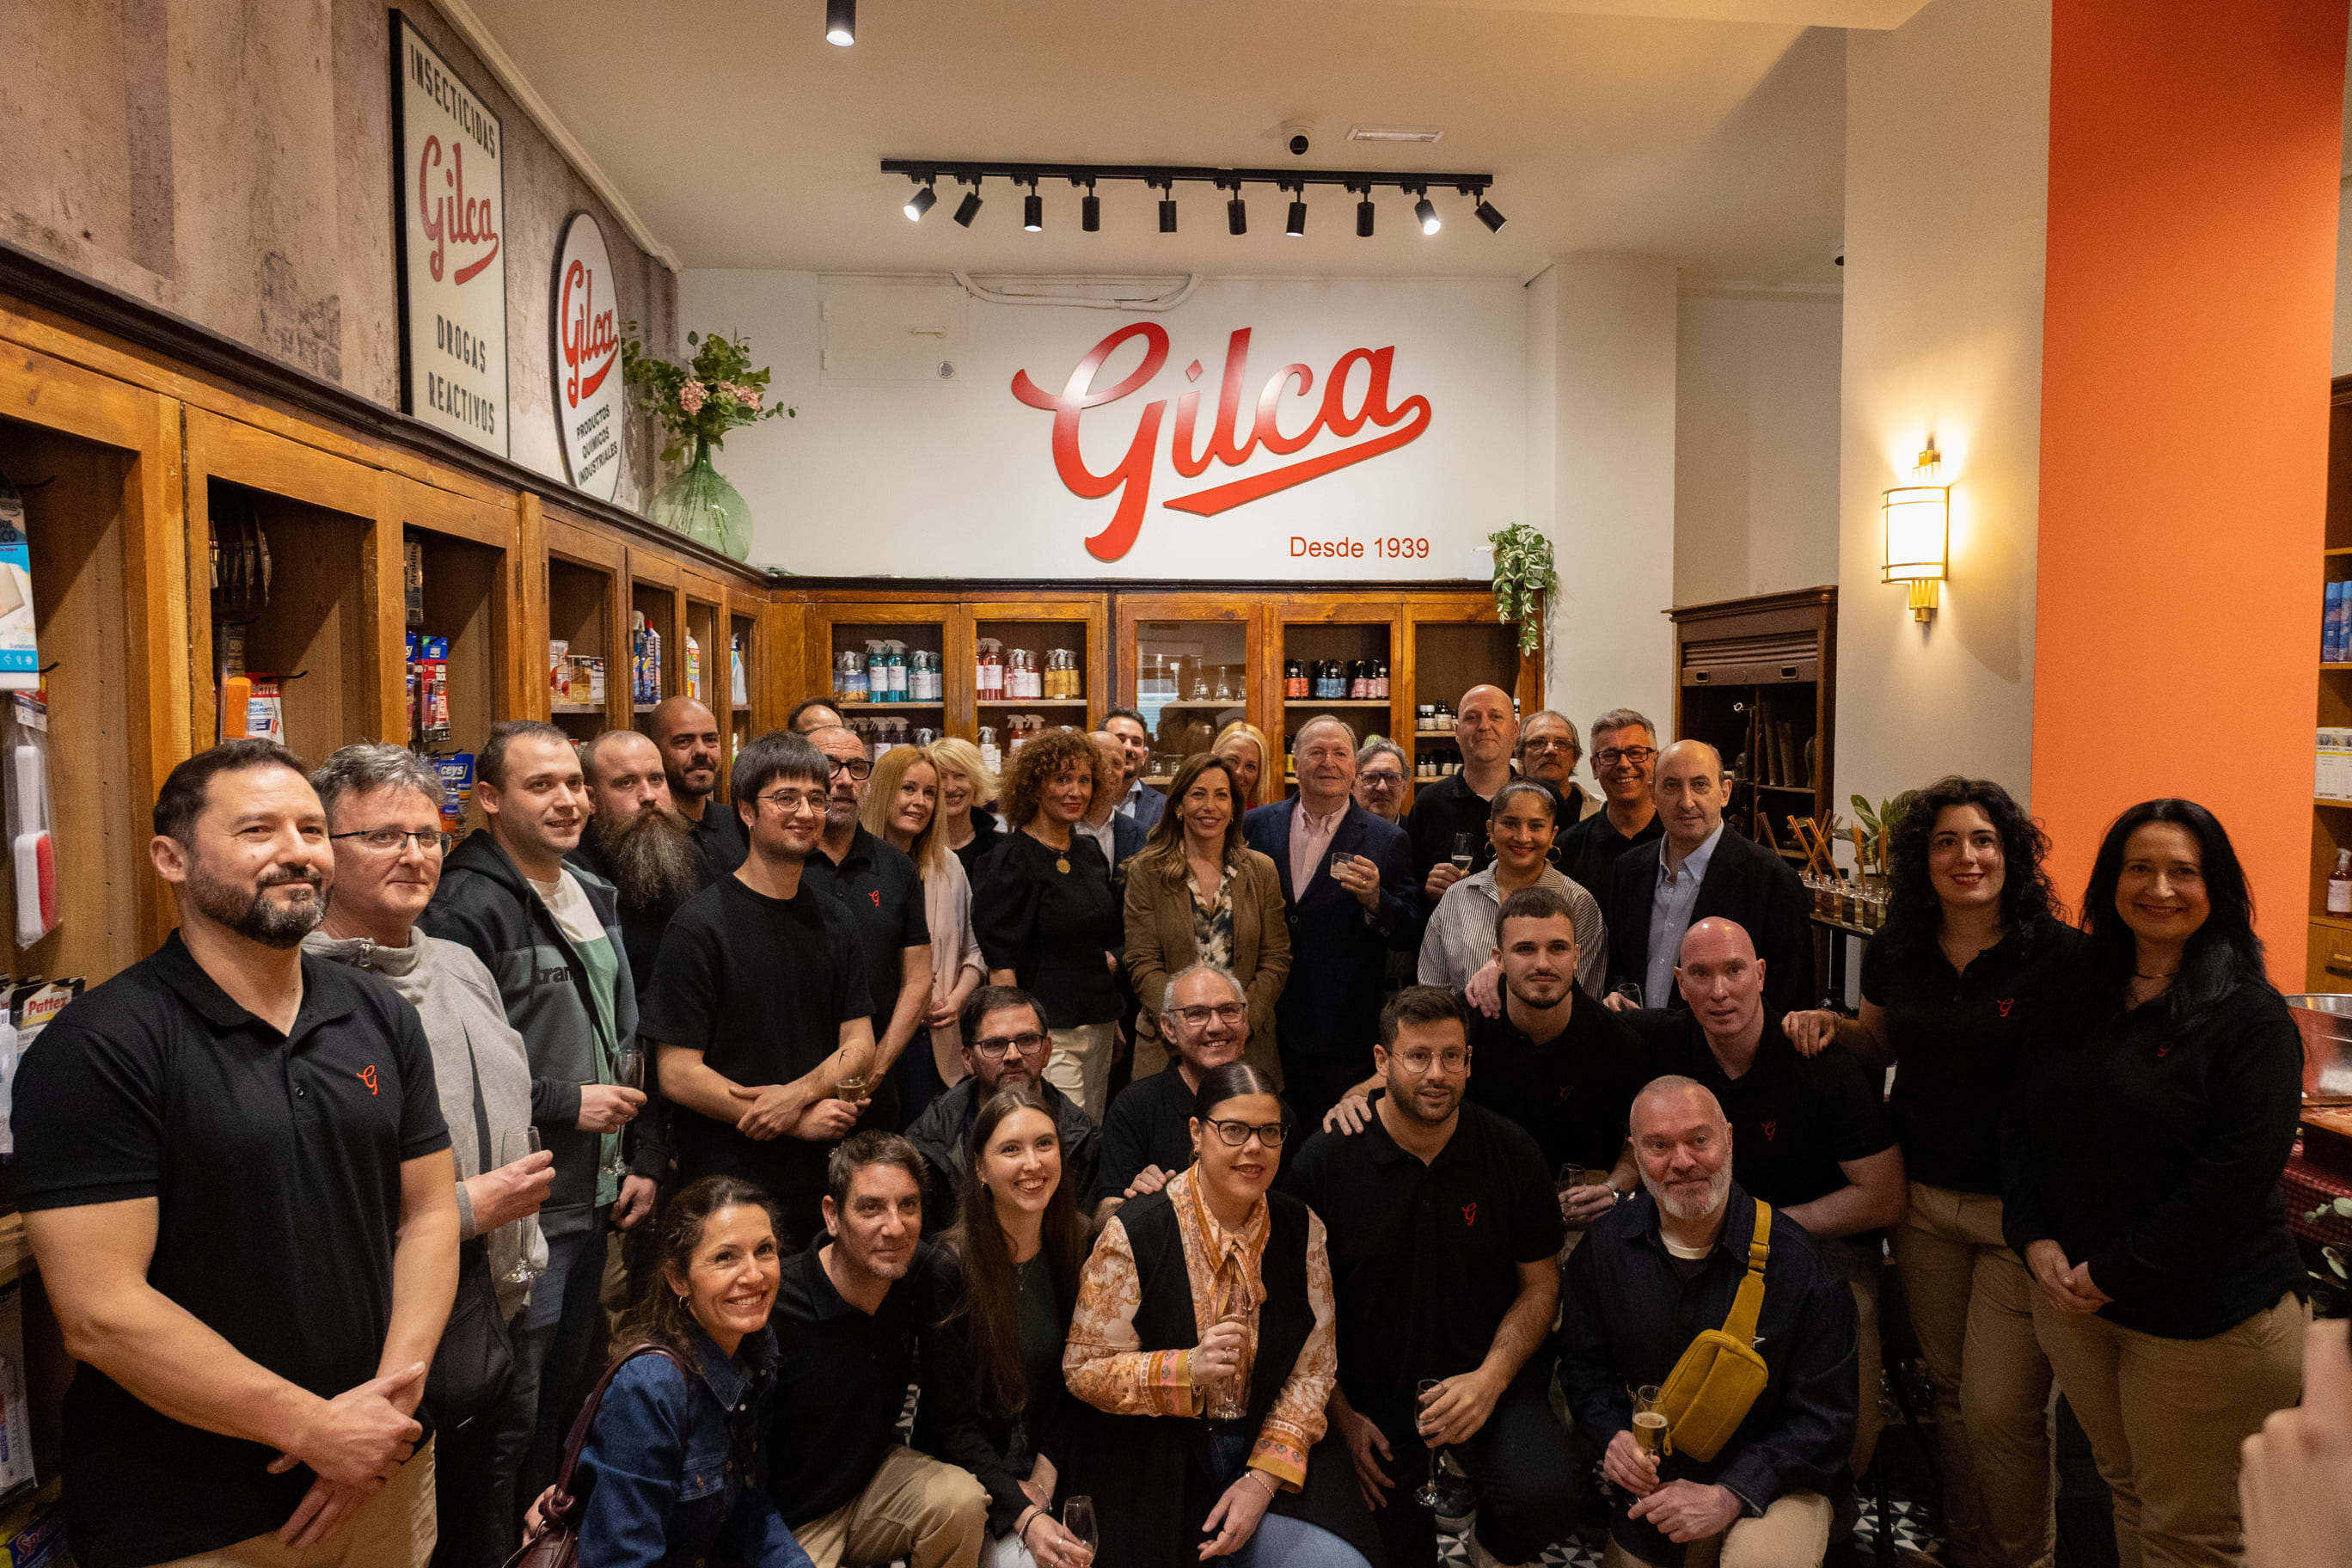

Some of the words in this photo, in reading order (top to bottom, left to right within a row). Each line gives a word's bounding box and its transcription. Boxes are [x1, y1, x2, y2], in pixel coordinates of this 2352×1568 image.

[410, 44, 496, 159] INSECTICIDAS
[420, 135, 499, 285] Gilca
[438, 314, 486, 374] DROGAS
[561, 260, 619, 408] Gilca
[429, 371, 495, 435] REACTIVOS
[576, 403, 610, 442] PRODUCTOS
[578, 440, 618, 487] INDUSTRIALES
[1011, 322, 1432, 563] Gilca
[1290, 536, 1365, 559] Desde
[1374, 536, 1430, 559] 1939
[251, 683, 279, 695] OCTITE
[440, 765, 465, 777] ceys
[28, 996, 68, 1016] Pattex
[356, 1064, 379, 1096] G
